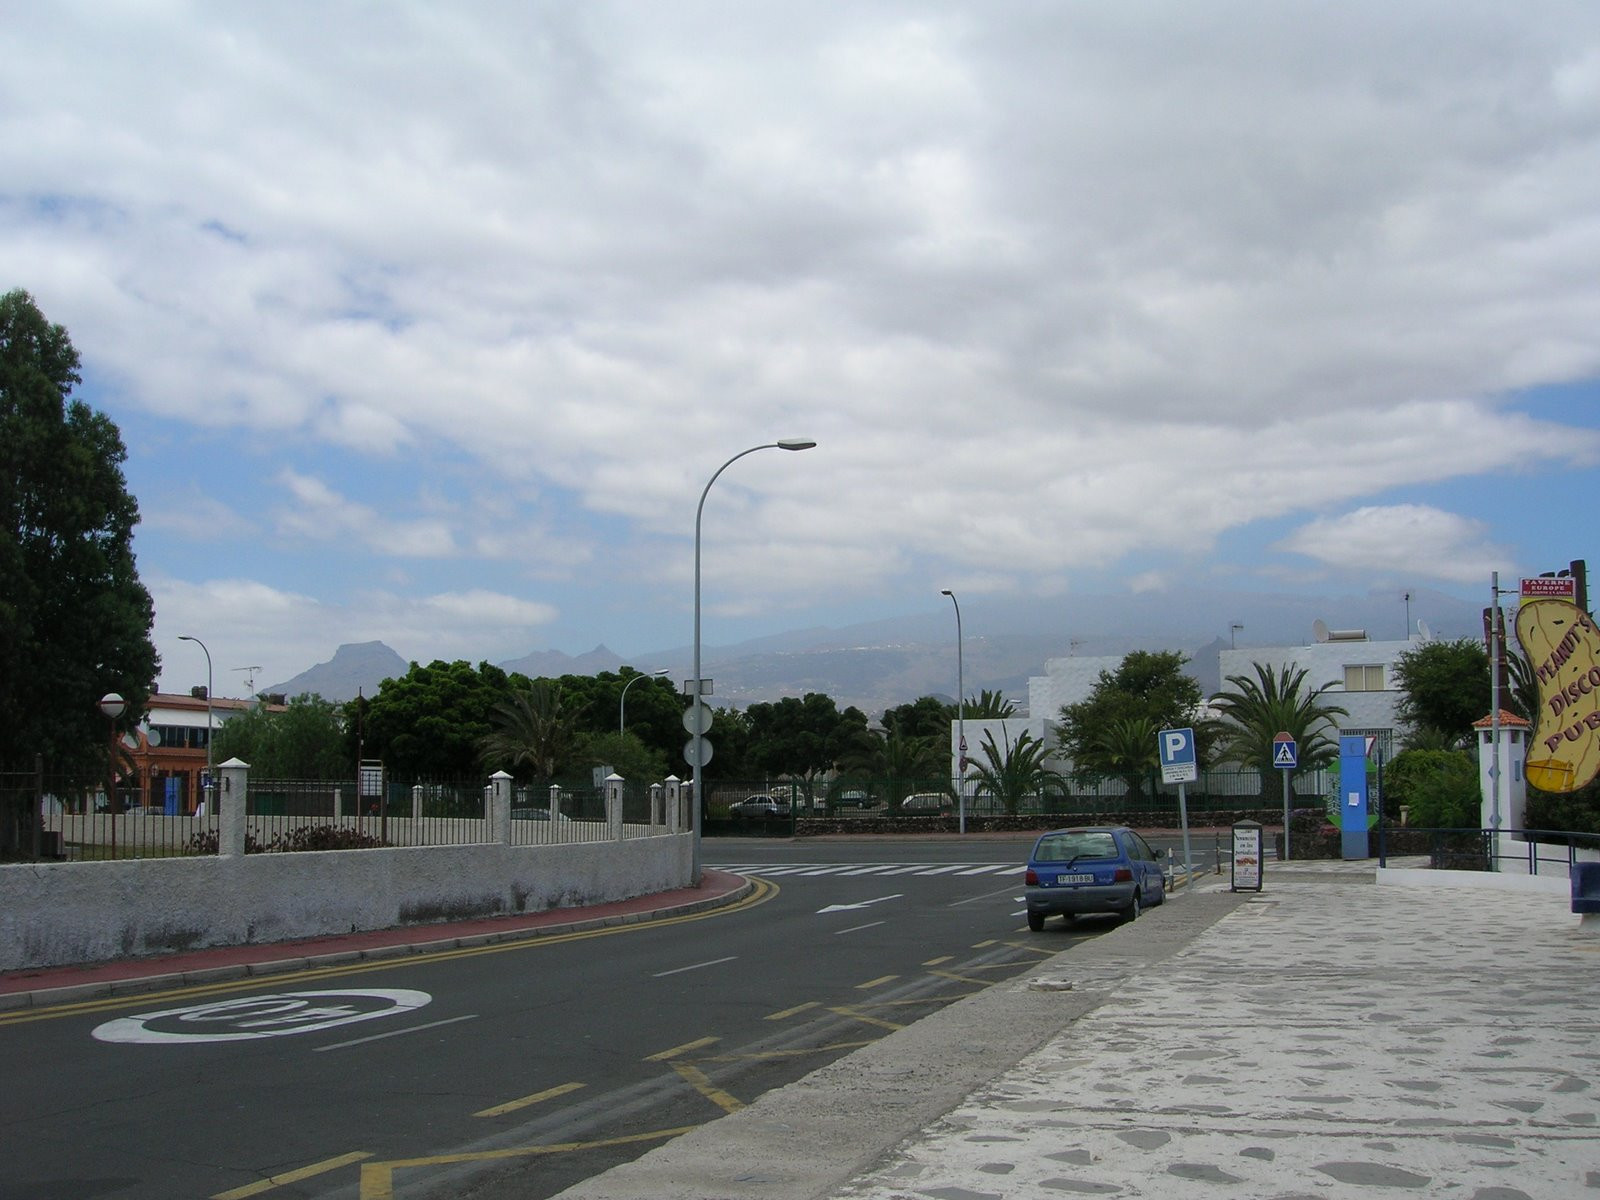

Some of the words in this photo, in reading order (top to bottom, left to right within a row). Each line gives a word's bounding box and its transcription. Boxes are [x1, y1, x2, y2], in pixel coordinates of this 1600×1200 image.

[1536, 614, 1591, 686] PEANUT'S
[1548, 665, 1600, 717] DISCO
[1166, 733, 1186, 760] P
[1544, 710, 1600, 754] PUB
